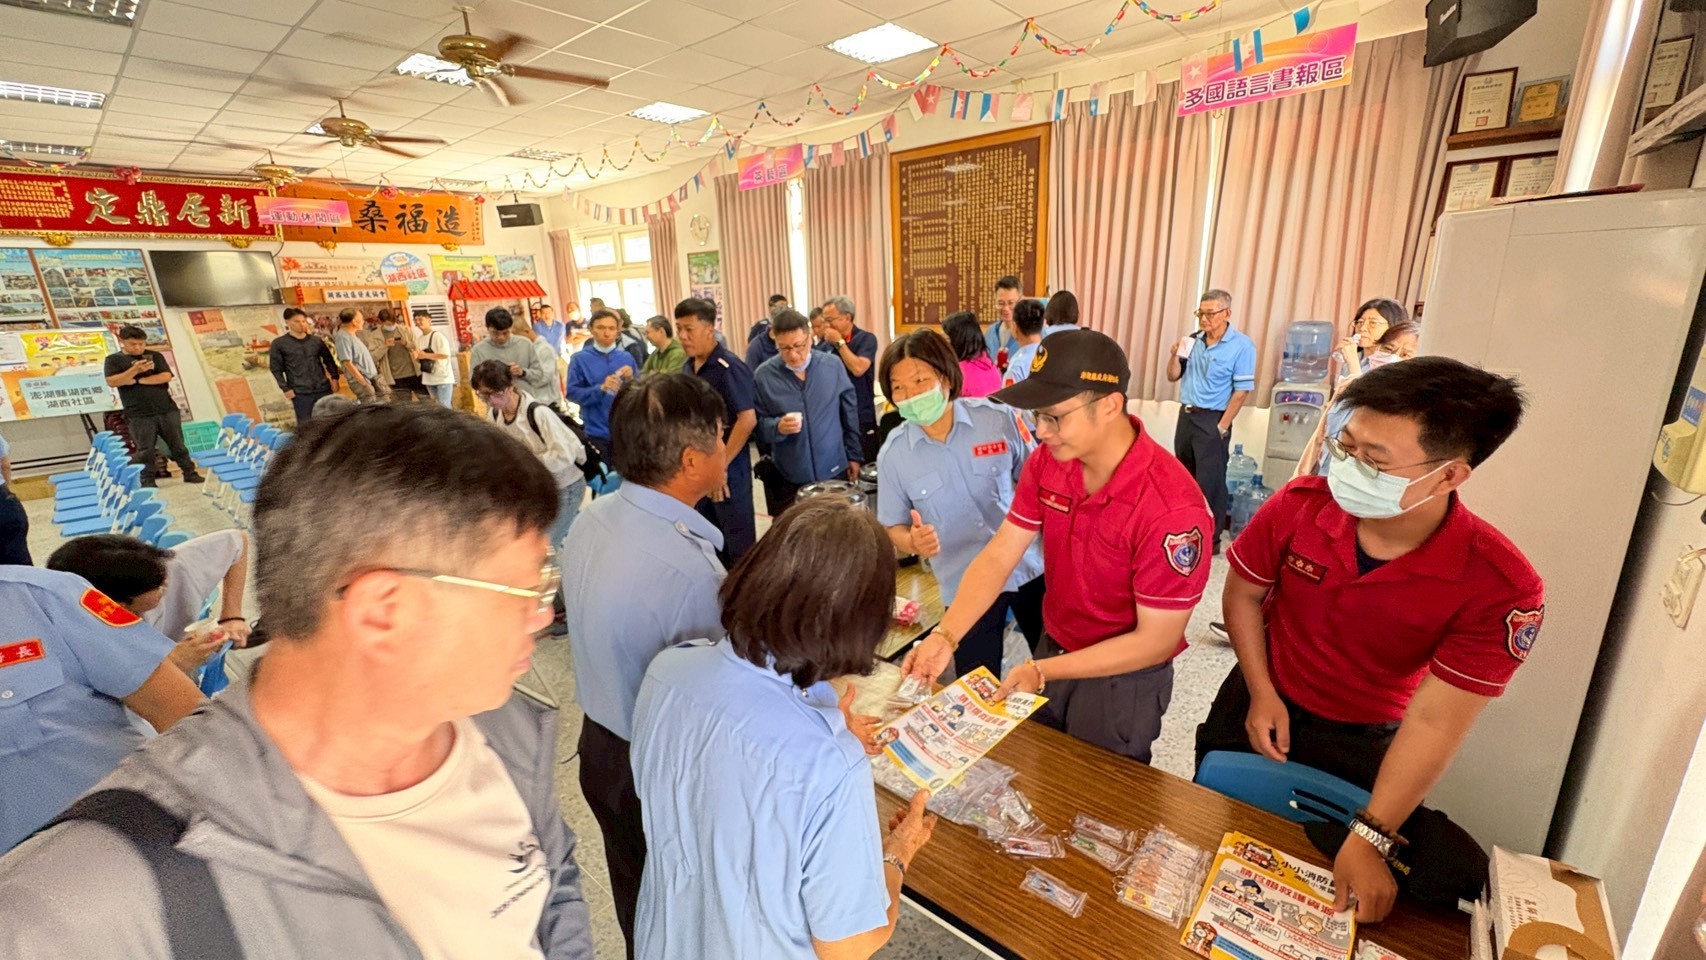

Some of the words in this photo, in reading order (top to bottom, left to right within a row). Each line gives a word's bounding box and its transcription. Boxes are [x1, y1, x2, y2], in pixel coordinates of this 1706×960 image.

[1185, 56, 1345, 108] 多國語言書報區
[271, 210, 341, 224] 運動休閒區
[330, 200, 467, 237] 造福桑
[385, 268, 428, 283] 湖西社區
[327, 290, 386, 299] 湖西社區發展協會
[29, 385, 104, 401] 澎湖縣湖西鄉
[47, 396, 96, 409] 湖西社區
[0, 645, 34, 664] 長
[1240, 866, 1335, 917] 請珍惜救護資源
